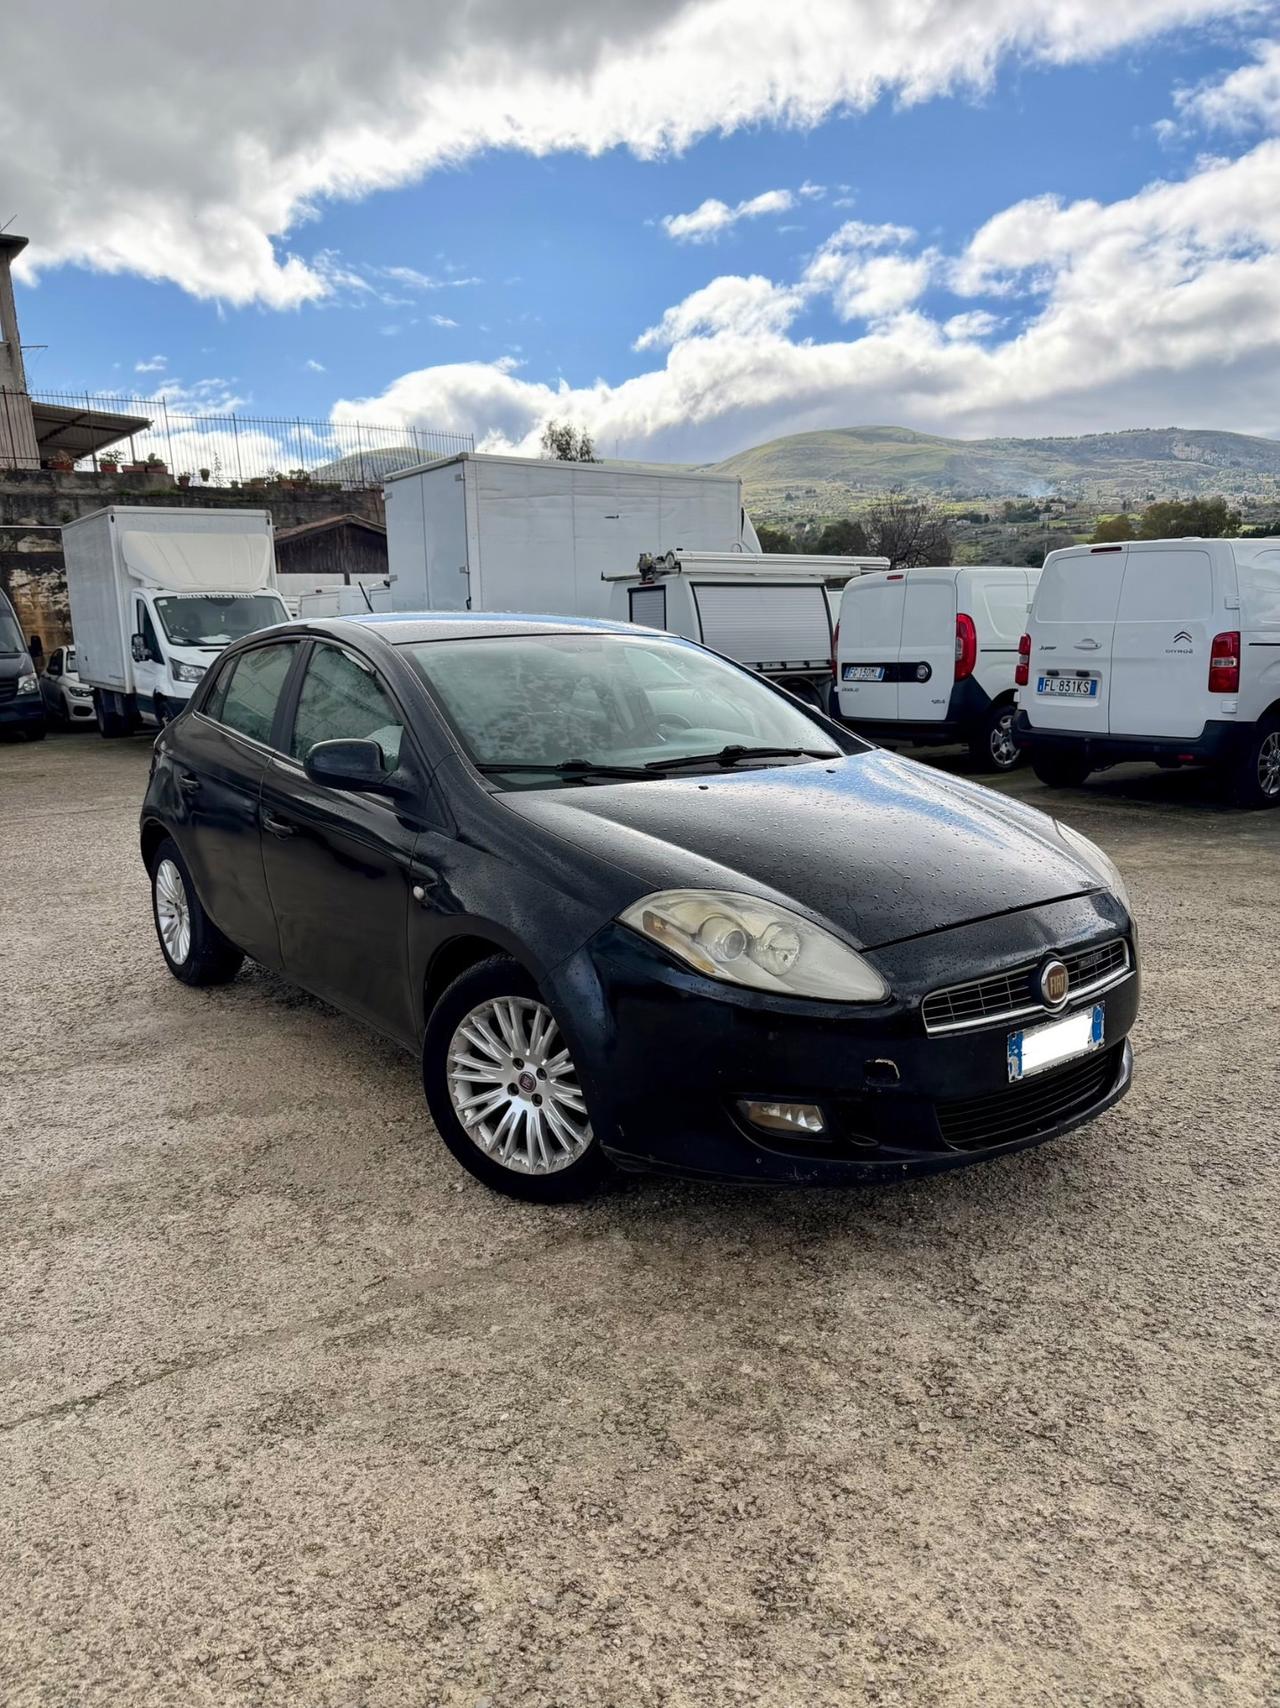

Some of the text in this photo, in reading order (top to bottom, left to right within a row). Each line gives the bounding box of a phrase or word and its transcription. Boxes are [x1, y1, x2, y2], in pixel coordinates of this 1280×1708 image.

[1044, 679, 1056, 692] FL
[1058, 680, 1090, 694] 831KS
[1050, 973, 1065, 996] FIAT
